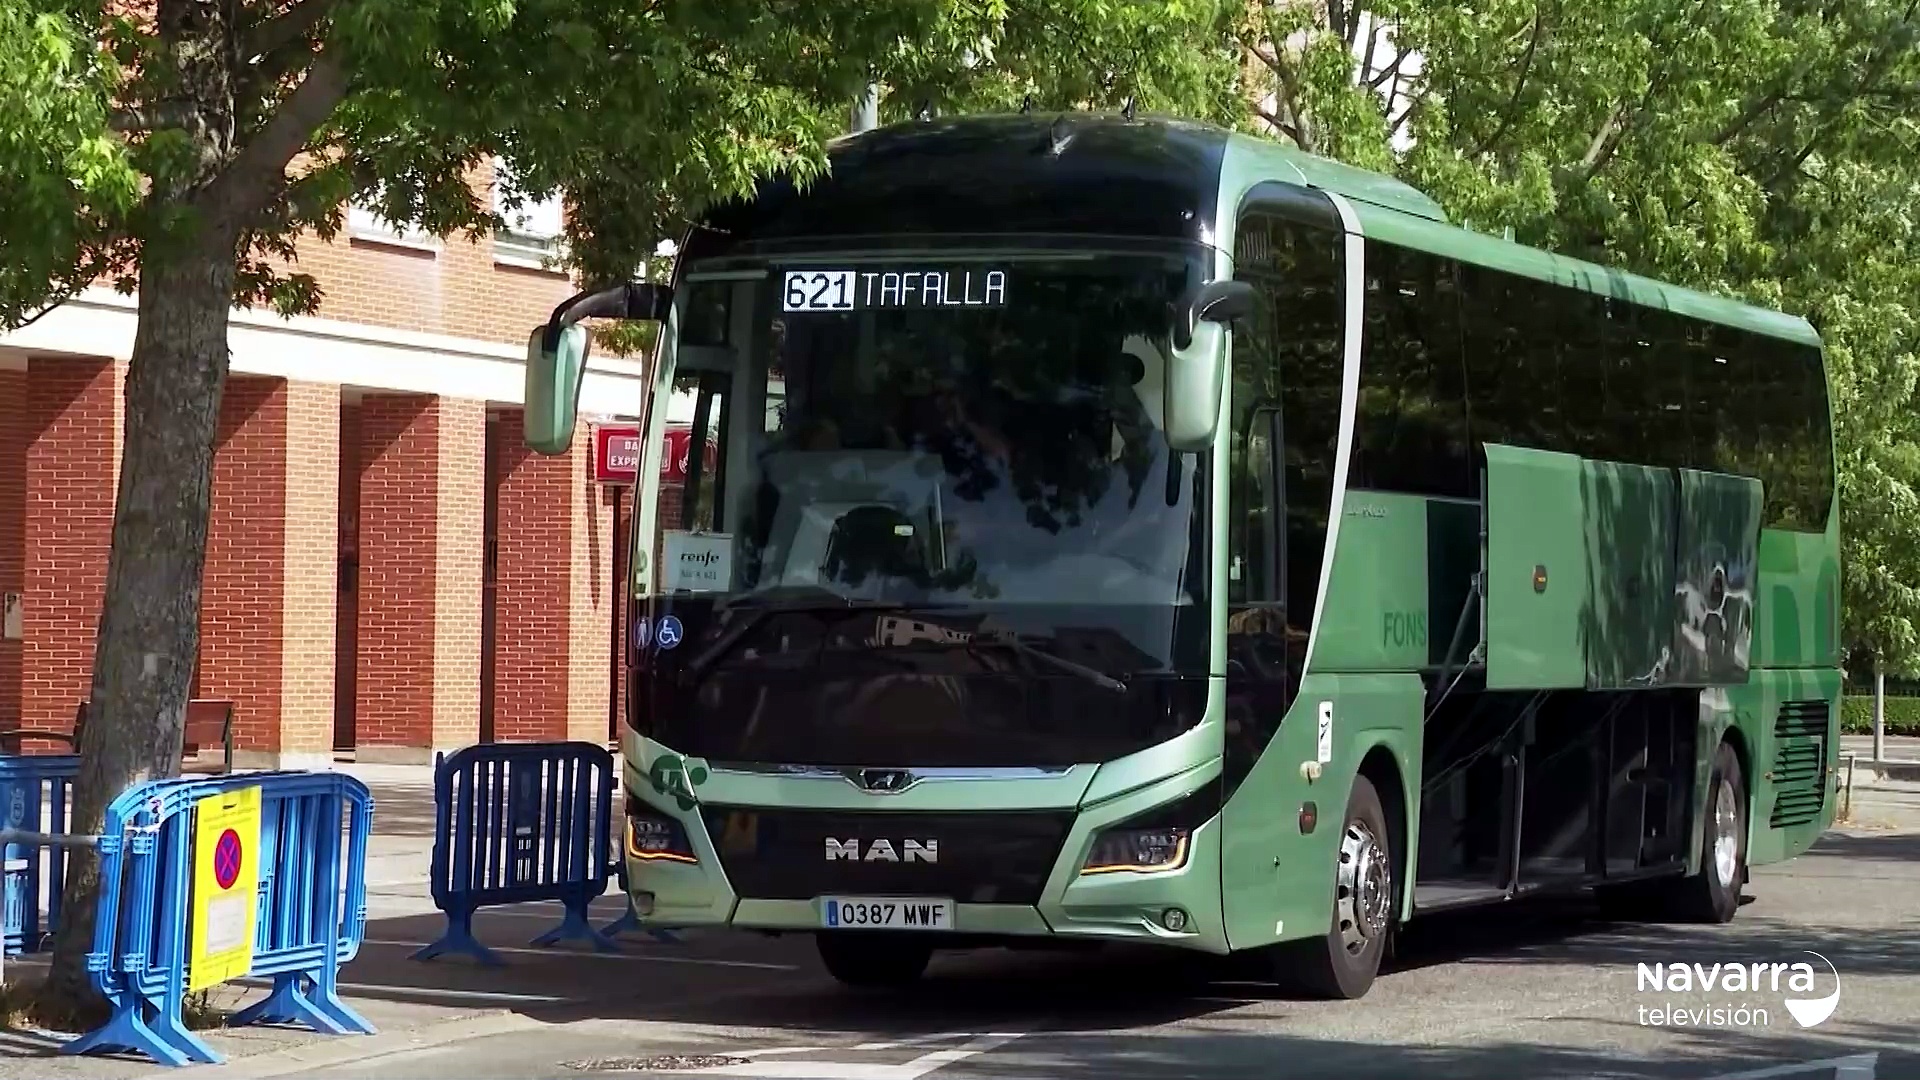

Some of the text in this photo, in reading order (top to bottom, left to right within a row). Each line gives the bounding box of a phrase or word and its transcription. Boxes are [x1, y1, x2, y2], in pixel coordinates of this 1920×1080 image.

[786, 271, 1005, 309] 621 TAFALLA
[681, 548, 720, 568] renfe
[825, 836, 938, 863] MAN
[842, 903, 945, 926] 0387 MWF
